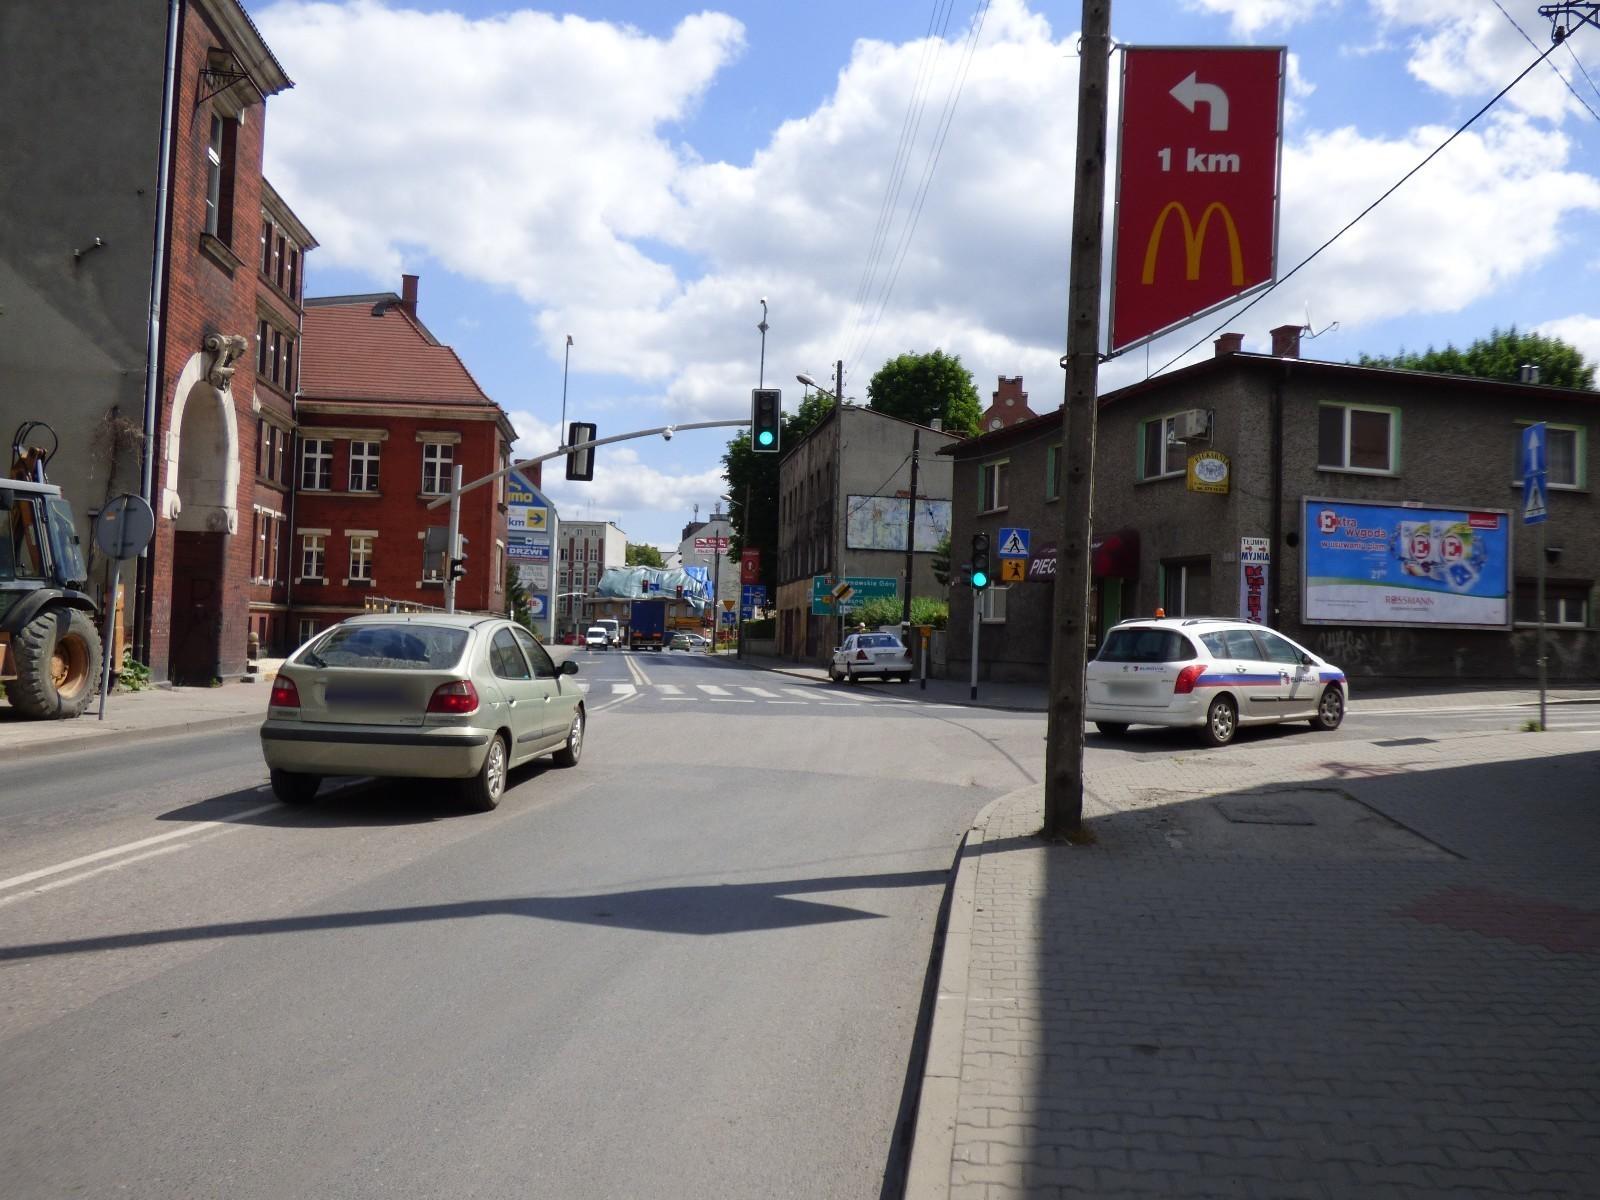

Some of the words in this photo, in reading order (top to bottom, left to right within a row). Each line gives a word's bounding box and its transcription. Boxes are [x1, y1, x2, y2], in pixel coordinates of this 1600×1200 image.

[1158, 148, 1171, 172] 1
[1187, 148, 1240, 173] km
[507, 492, 533, 503] ma
[508, 517, 525, 526] km
[1320, 511, 1357, 534] Extra
[1346, 527, 1387, 540] wygoda
[508, 548, 543, 556] DRZWI
[1241, 552, 1270, 560] MYJNIA
[1029, 558, 1057, 576] PIEC
